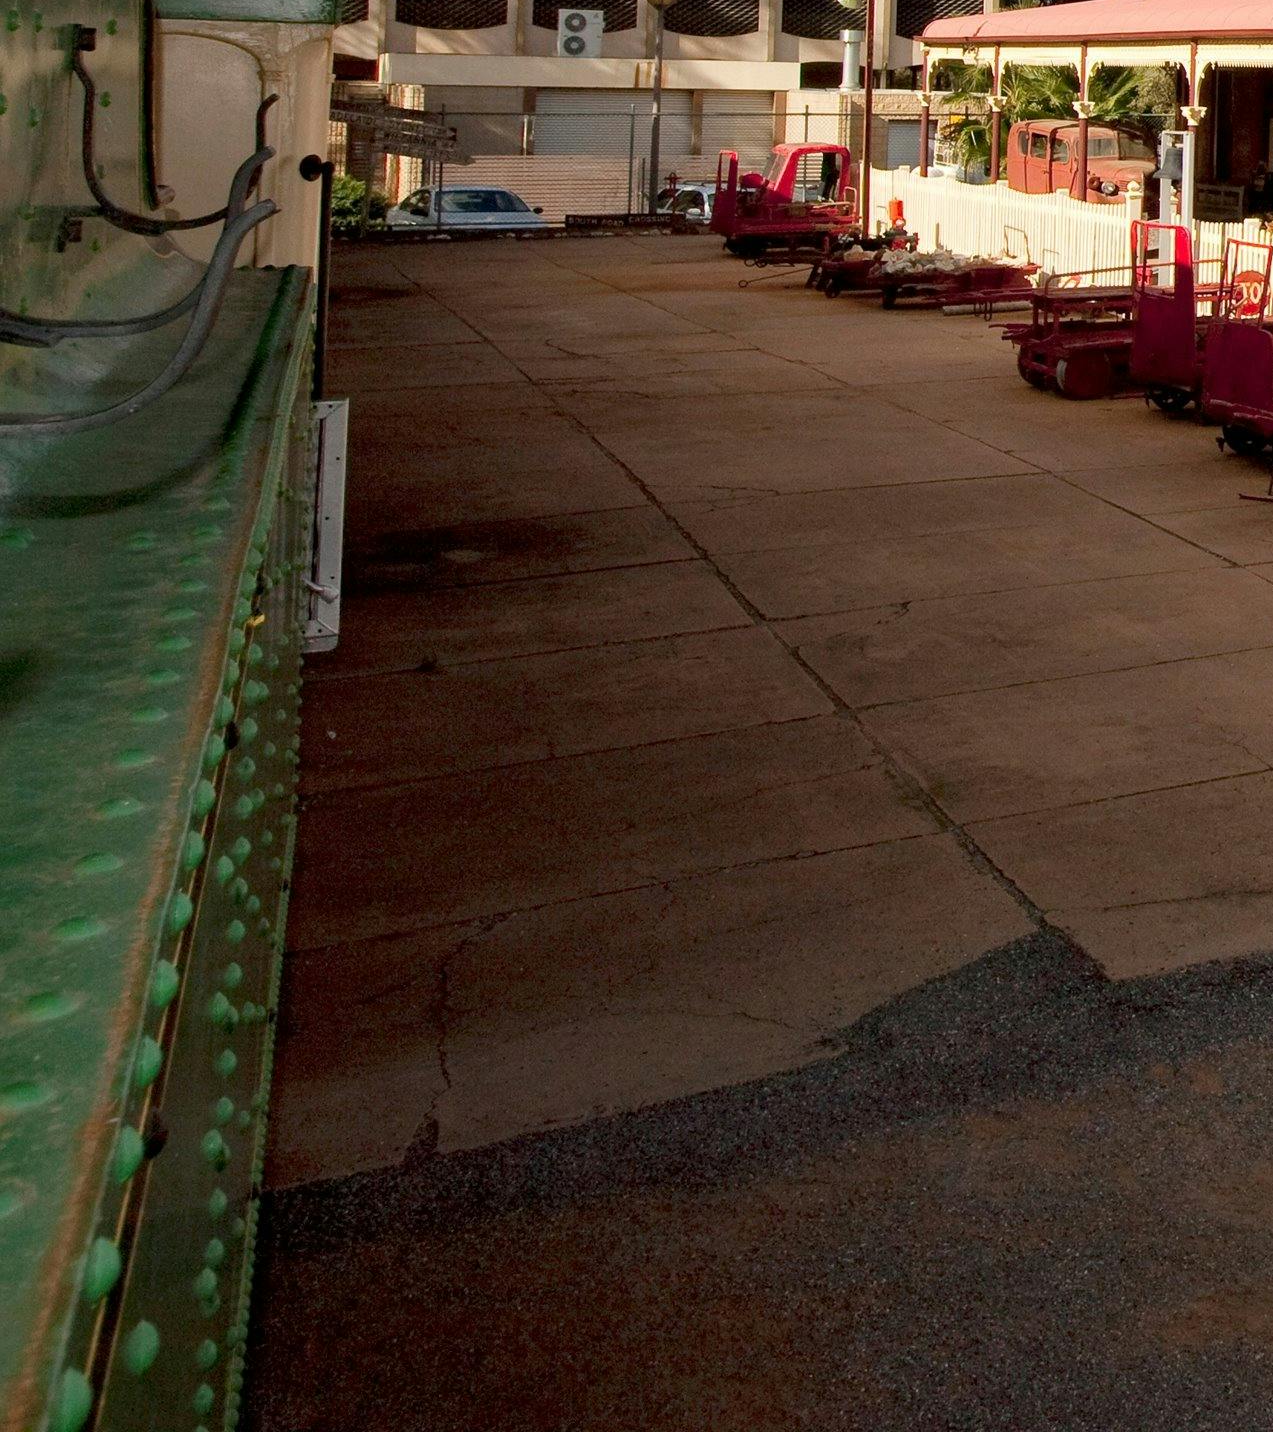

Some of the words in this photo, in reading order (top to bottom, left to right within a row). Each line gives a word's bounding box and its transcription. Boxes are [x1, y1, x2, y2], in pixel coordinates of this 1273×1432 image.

[568, 217, 598, 225] SOUTH
[602, 219, 624, 227] ROAD
[628, 215, 672, 223] CROSSING
